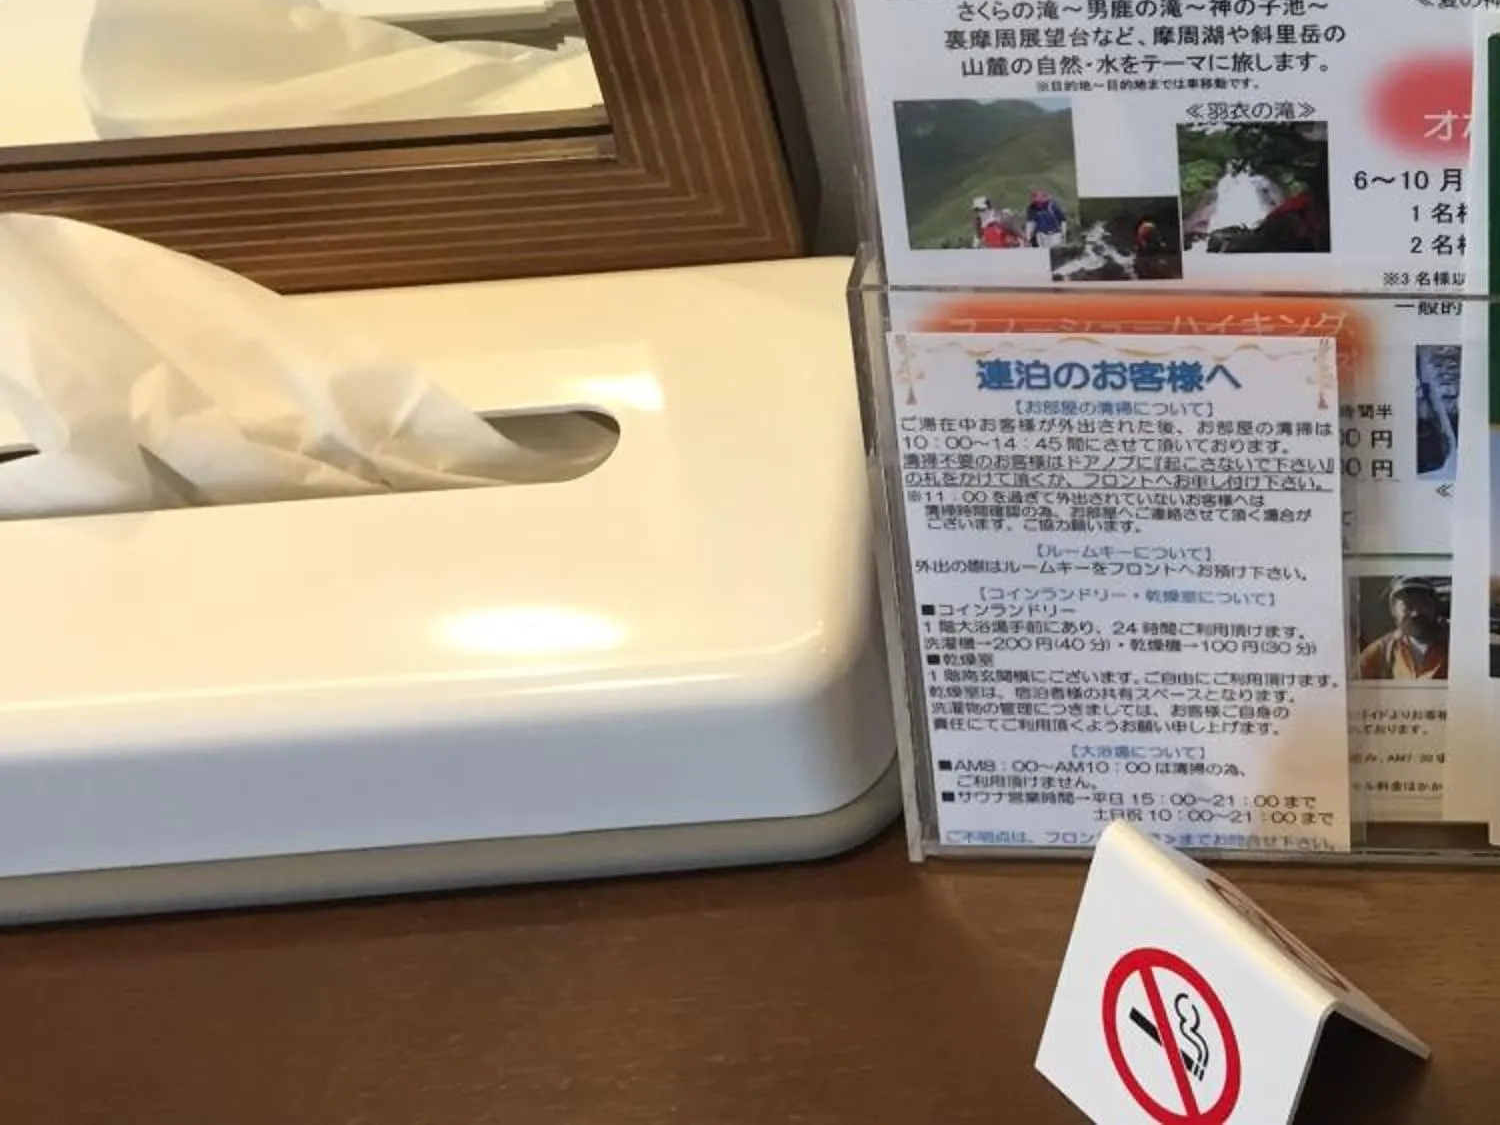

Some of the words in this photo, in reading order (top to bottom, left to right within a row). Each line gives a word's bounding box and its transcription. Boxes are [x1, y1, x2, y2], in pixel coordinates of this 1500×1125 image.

[976, 358, 1242, 393] 連泊のお客様へ
